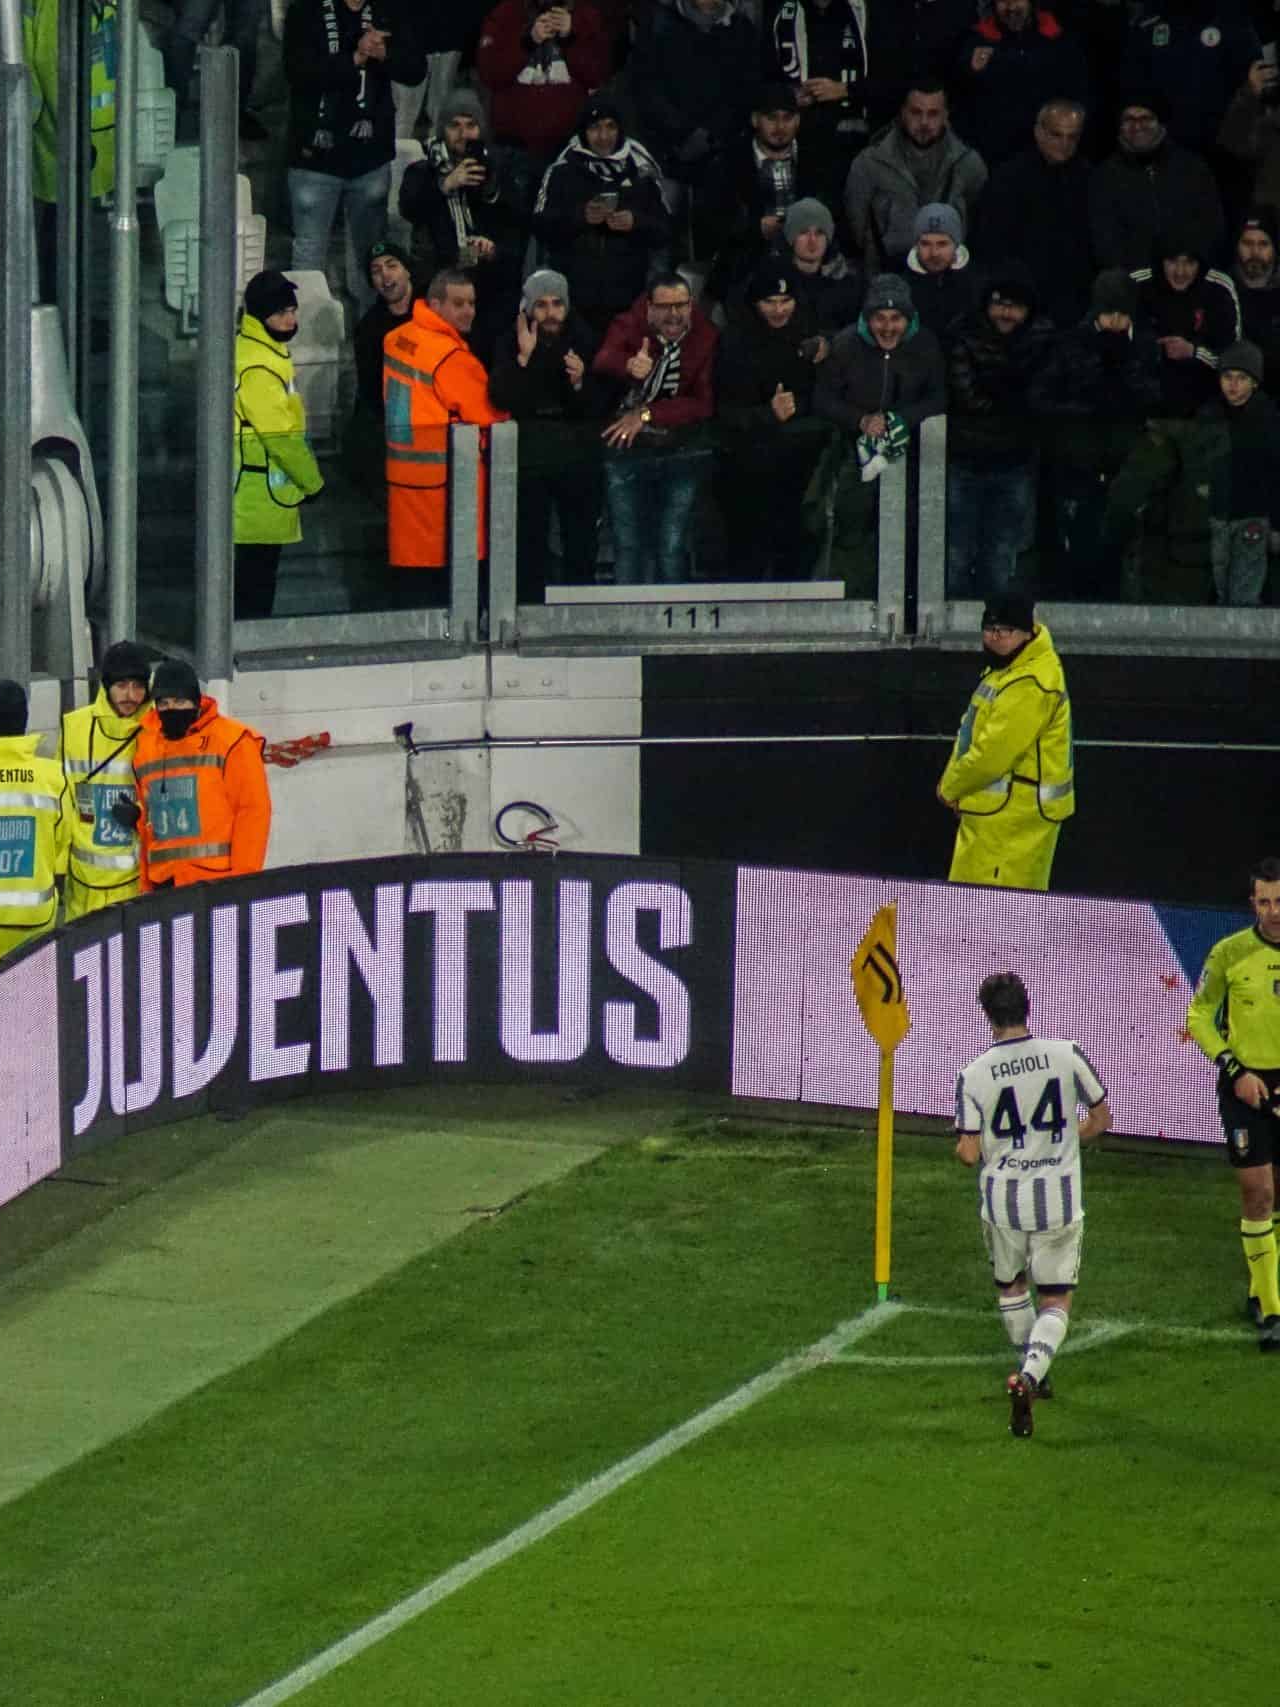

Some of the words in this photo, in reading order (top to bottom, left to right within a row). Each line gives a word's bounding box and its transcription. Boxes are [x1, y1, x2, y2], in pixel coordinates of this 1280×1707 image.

[663, 606, 721, 628] 111
[72, 879, 693, 1137] JUVENTUS
[990, 1053, 1050, 1080] FAGIOLI
[991, 1077, 1068, 1150] 44
